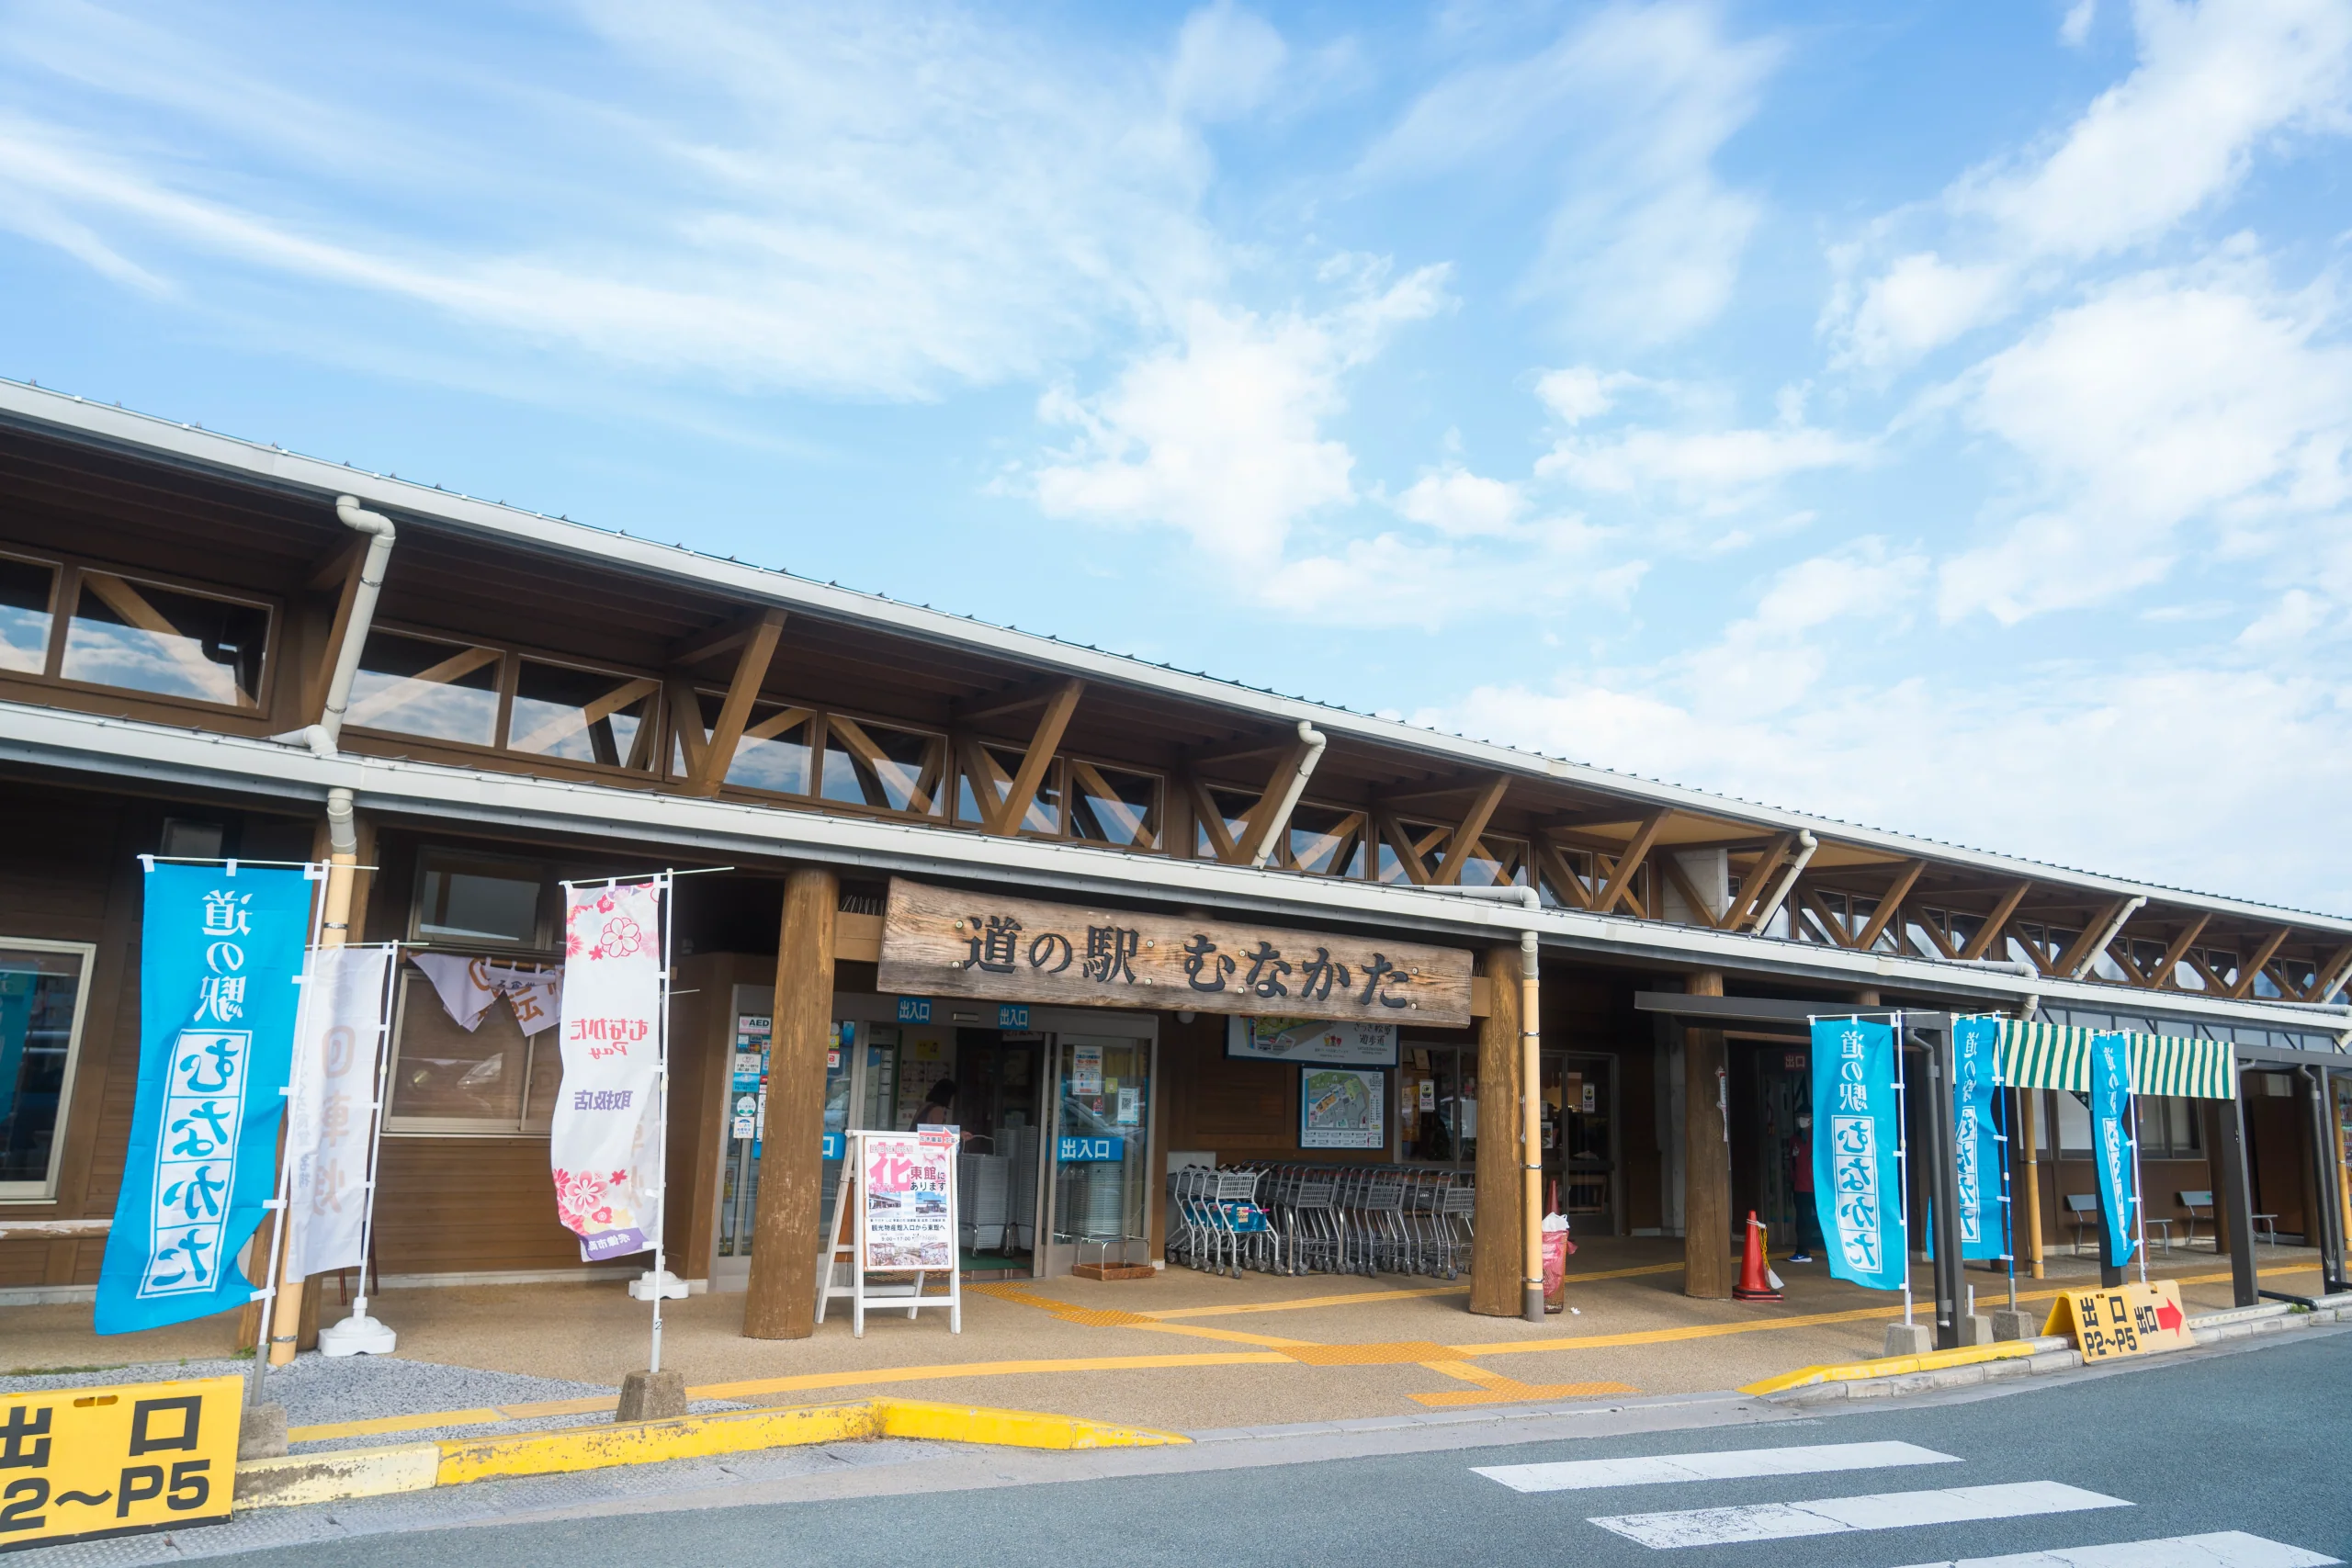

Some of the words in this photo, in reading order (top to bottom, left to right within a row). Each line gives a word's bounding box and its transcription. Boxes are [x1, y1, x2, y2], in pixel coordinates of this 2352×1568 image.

[963, 915, 1138, 985] 道の駅
[1184, 934, 1410, 1009] むなかた
[899, 1001, 931, 1021] 出入口
[1000, 1008, 1028, 1027] 出入口
[749, 1019, 769, 1027] AED
[1359, 1033, 1385, 1045] 遊歩道
[1786, 1055, 1805, 1067] 出口
[1061, 1139, 1110, 1159] 出入口
[869, 1142, 914, 1191] 花
[910, 1166, 945, 1180] 東館に
[910, 1181, 946, 1191] あります
[2080, 1296, 2128, 1327] 出口
[2134, 1305, 2159, 1335] 出口
